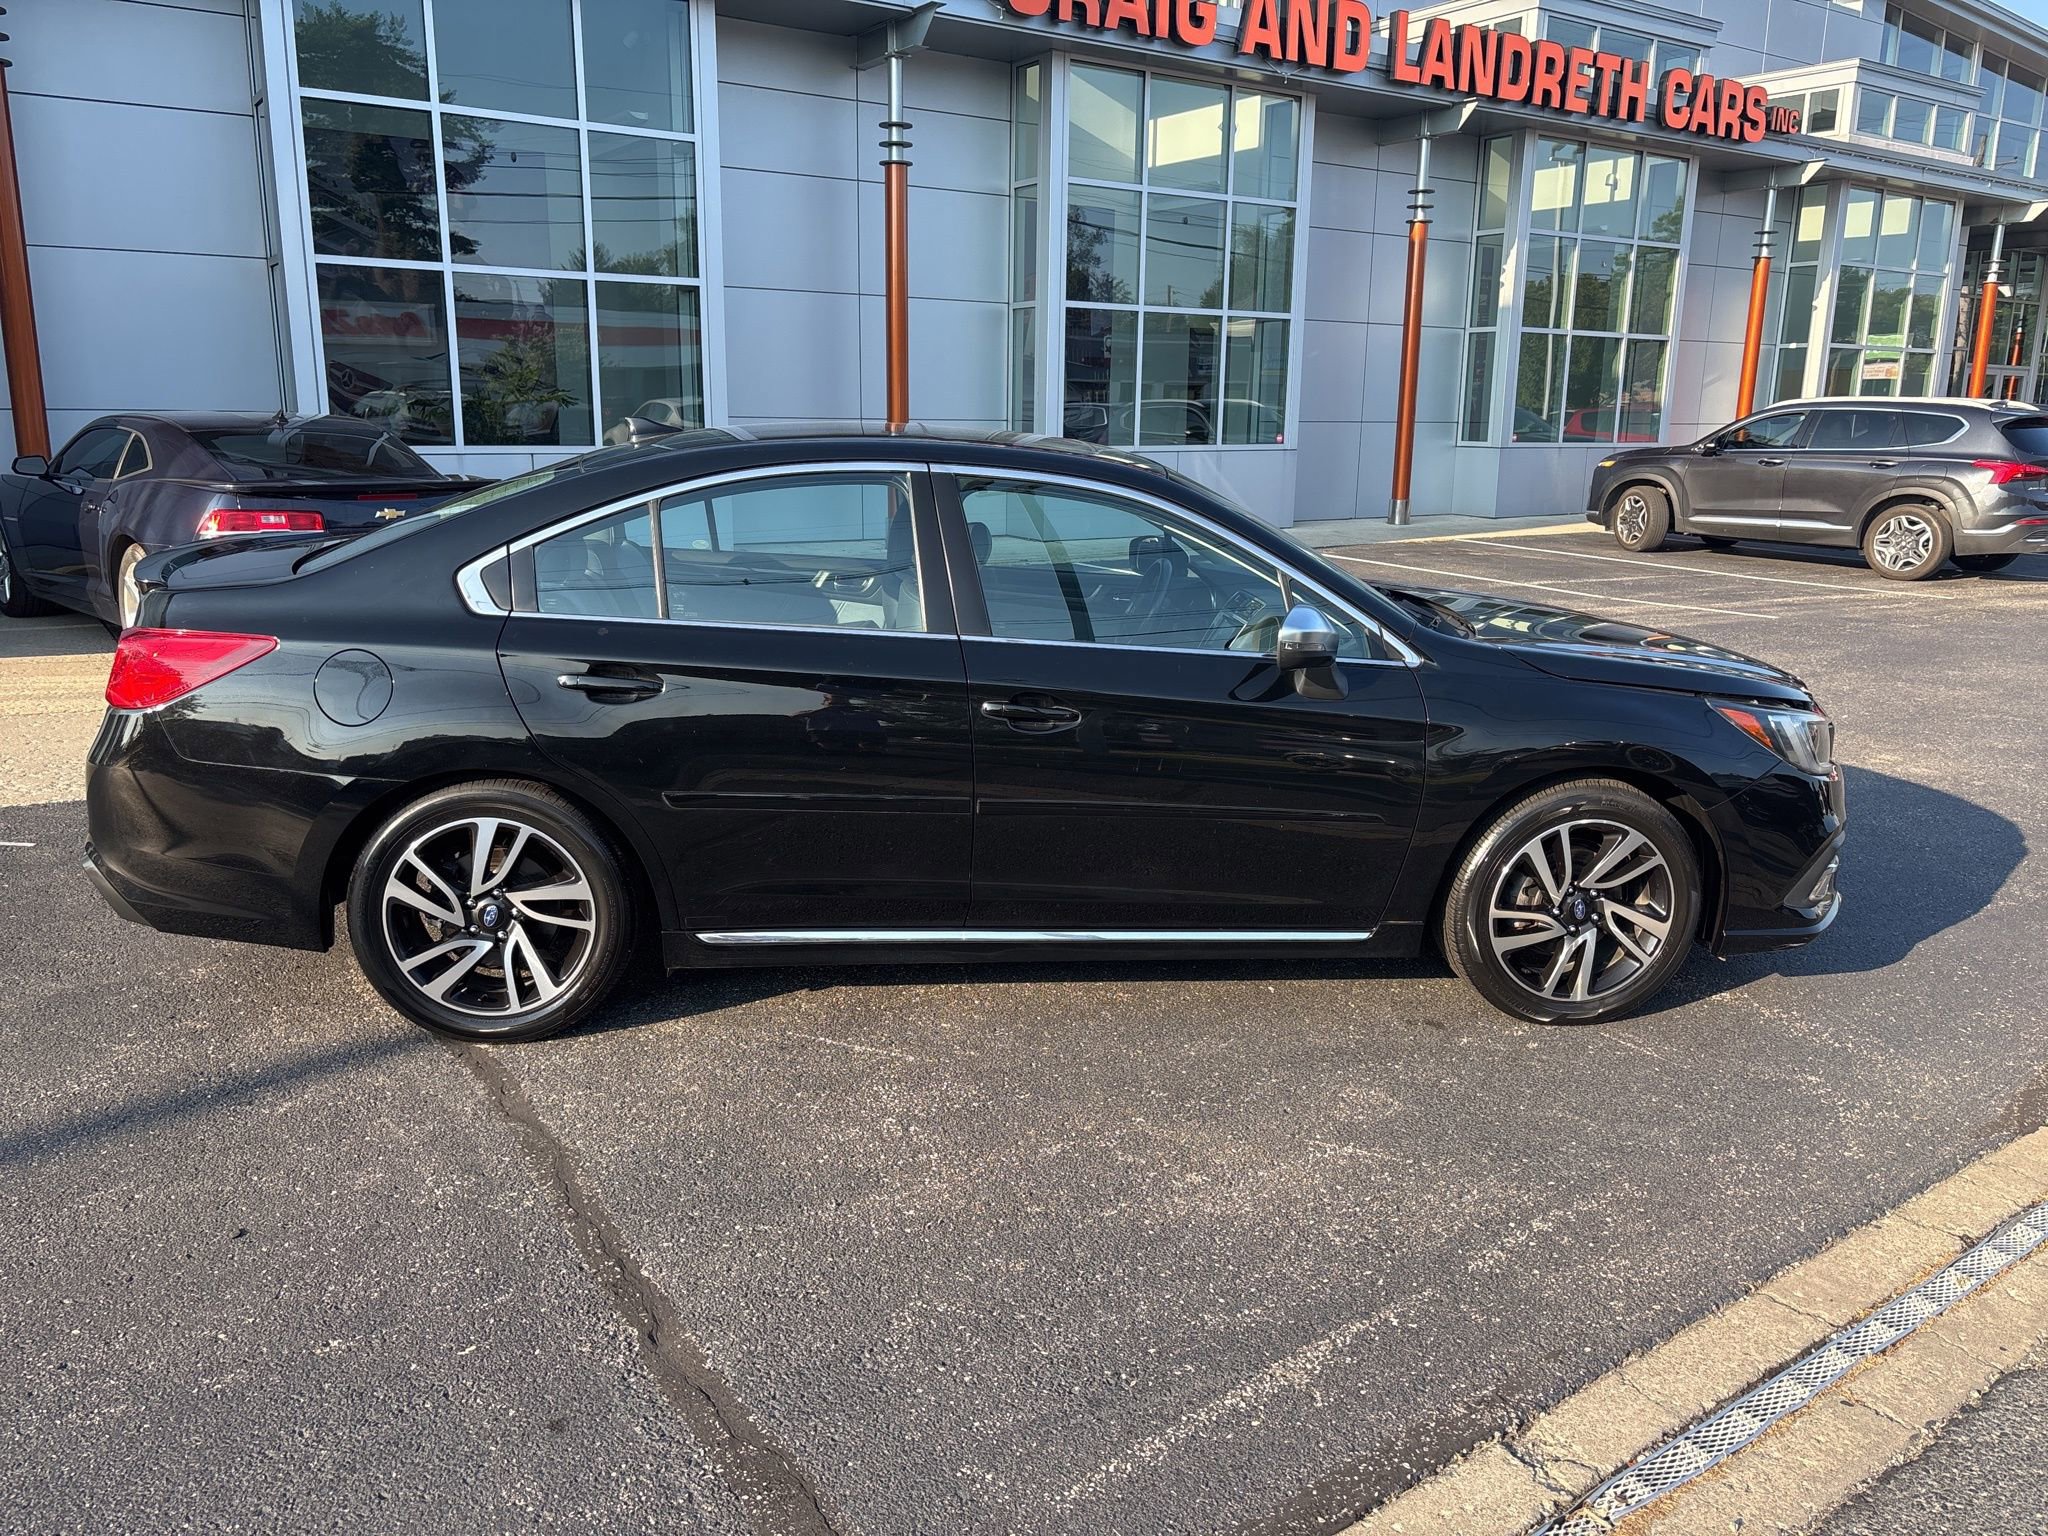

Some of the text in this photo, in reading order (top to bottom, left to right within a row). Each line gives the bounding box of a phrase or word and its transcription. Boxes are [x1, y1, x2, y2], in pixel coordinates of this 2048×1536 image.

[1008, 0, 1799, 143] AIG AND LANDRETH CARS INC
